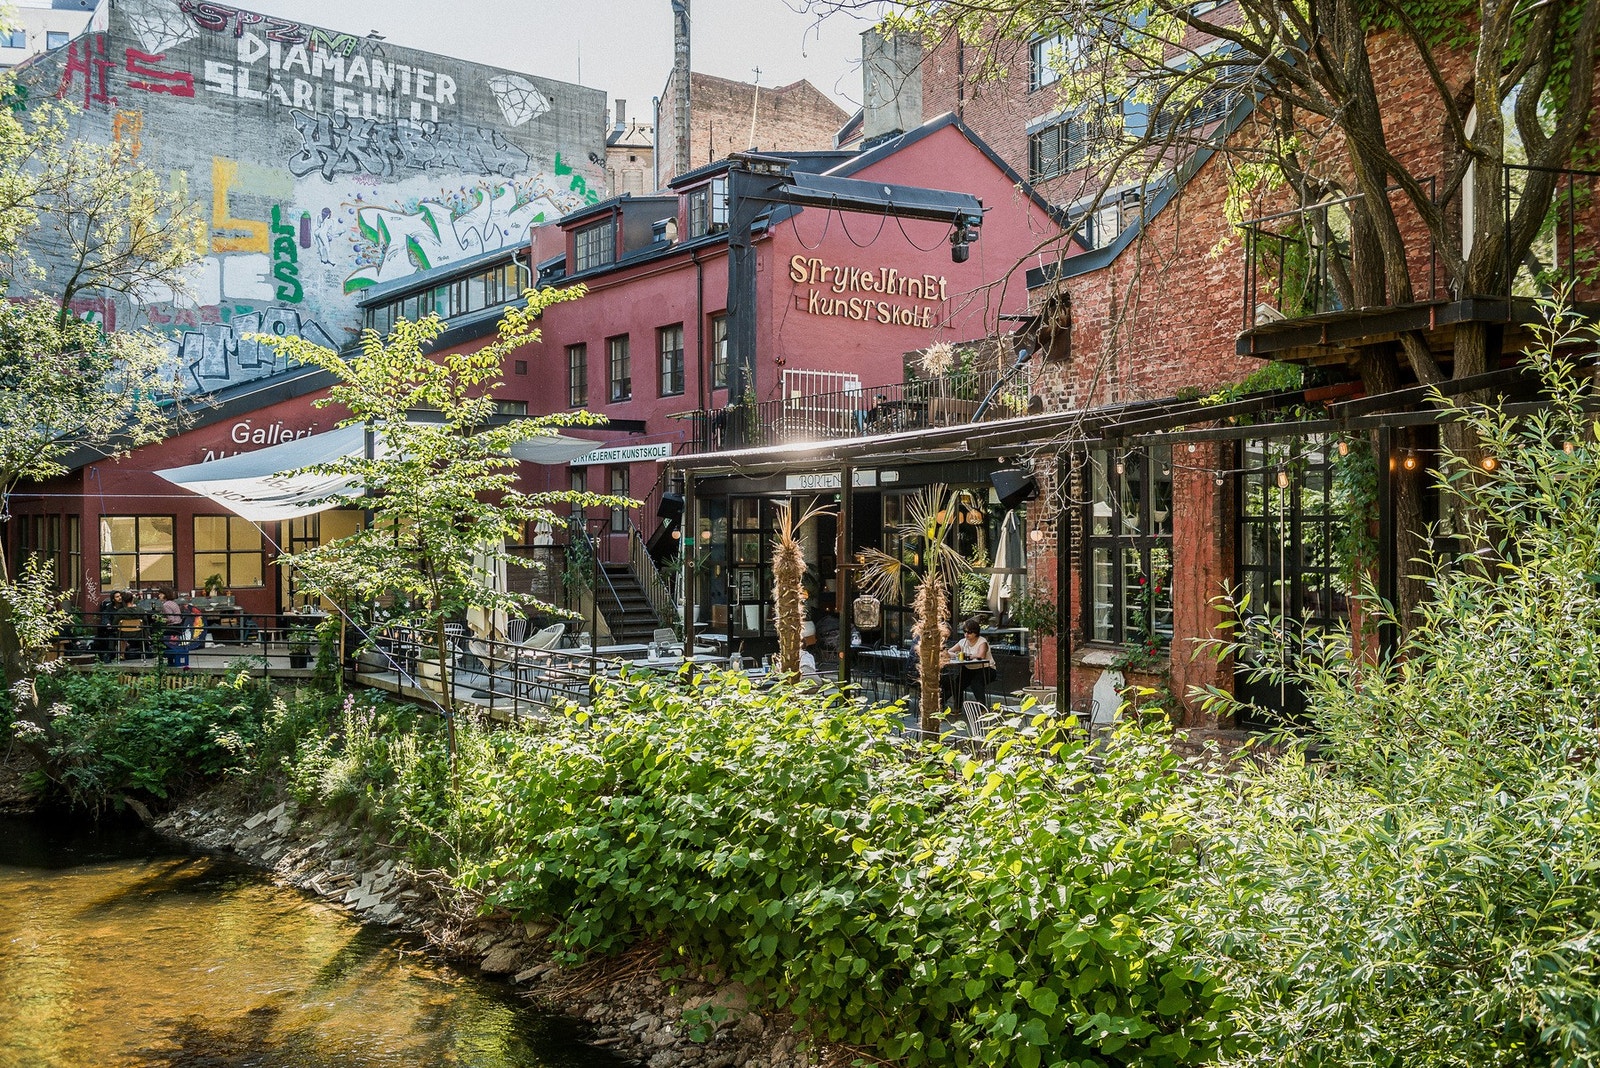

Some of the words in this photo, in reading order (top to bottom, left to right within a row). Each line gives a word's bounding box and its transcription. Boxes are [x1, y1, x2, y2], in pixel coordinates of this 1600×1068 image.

[236, 31, 457, 105] DIAMANTER
[269, 203, 304, 303] LAS
[231, 421, 312, 444] Galleri
[622, 446, 666, 459] KUNSTSKOLE
